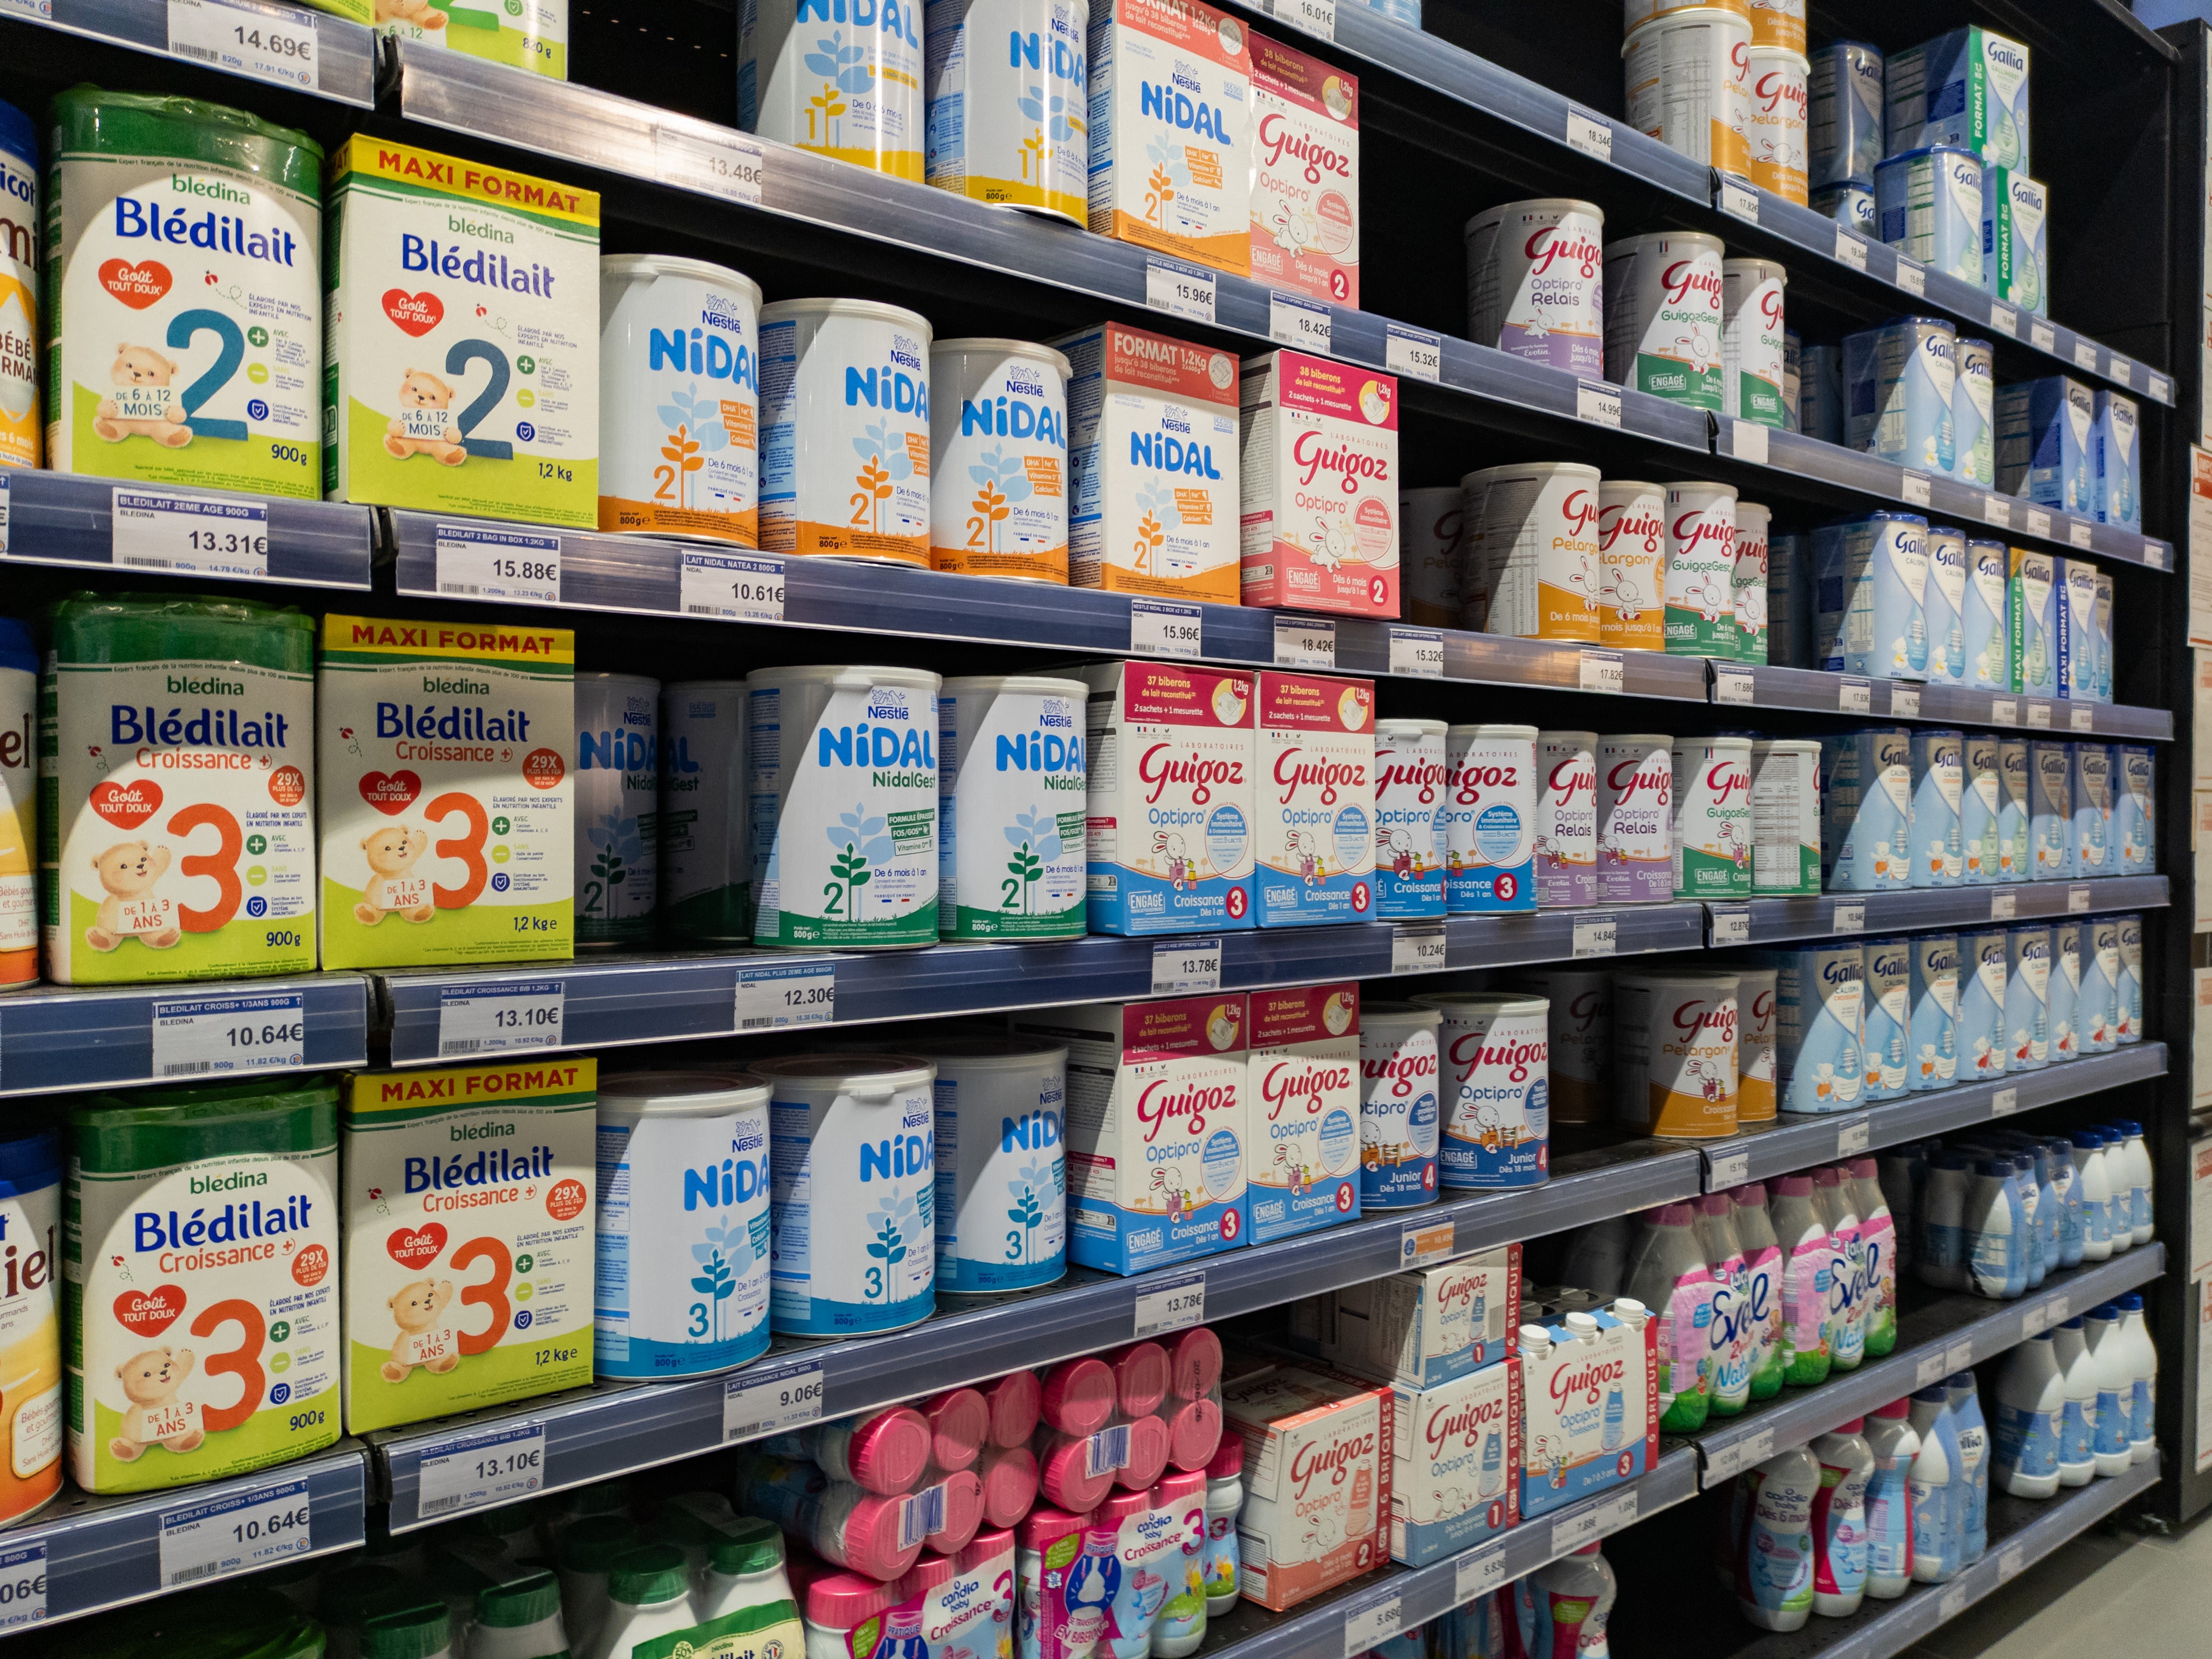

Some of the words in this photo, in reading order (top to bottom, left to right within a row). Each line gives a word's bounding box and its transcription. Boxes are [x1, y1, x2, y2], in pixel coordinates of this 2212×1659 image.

[1301, 1, 1333, 25] 16.01€
[234, 25, 311, 60] 14.69€
[1274, 51, 1304, 73] biberons
[1988, 42, 2023, 72] Gallia
[1294, 120, 1350, 147] LABORATOIRES
[1260, 113, 1349, 184] Guigoz
[379, 150, 454, 184] MAXI
[465, 171, 580, 213] FORMAT
[709, 156, 762, 184] 13.48€
[172, 173, 250, 206] blédina
[2012, 181, 2042, 212] Gallia
[1740, 199, 1758, 215] 17.82€
[116, 196, 297, 267] Blédilait
[449, 215, 514, 244] blédina
[402, 233, 554, 299] Blédilait
[1252, 248, 1282, 271] ENGAGÉ
[118, 267, 153, 284] Goût
[398, 297, 428, 313] Goût
[1176, 284, 1212, 305] 15.96€
[1299, 319, 1331, 337] 18.42€
[1115, 333, 1177, 366] FORMAT
[1410, 351, 1437, 367] 15.32€
[167, 309, 248, 441] 2
[116, 392, 128, 401] DE
[132, 388, 140, 400] 6
[157, 389, 170, 402] 12
[445, 338, 514, 460] 2
[124, 403, 162, 416] MOIS
[1598, 402, 1621, 416] 14.99€
[1331, 432, 1388, 449] LABORATOIRES
[1294, 431, 1387, 494] Guigoz
[653, 465, 676, 499] 2
[120, 496, 172, 510] BLEDILAIT
[174, 501, 201, 512] 2EME
[203, 504, 224, 515] AGE
[226, 506, 249, 517] 900G
[120, 510, 156, 519] BLEDINA
[189, 530, 268, 556] 13.31€
[438, 541, 466, 549] BLEDINA
[439, 529, 475, 540] BLEDILAIT
[482, 533, 498, 542] BAG
[499, 534, 507, 543] IN
[508, 536, 522, 545] BOX
[493, 559, 557, 581] 15.88€
[686, 556, 702, 565] LAIT
[704, 557, 725, 567] NIDAL
[727, 561, 751, 569] NATEA
[758, 564, 775, 572] 800G
[732, 583, 784, 602] 10.61€
[352, 625, 427, 647] MAXI
[439, 631, 554, 655] FORMAT
[1163, 625, 1200, 641] 15.96€
[1302, 638, 1334, 653] 18.42€
[1415, 649, 1443, 662] 15.32€
[167, 675, 244, 696] blédina
[111, 705, 288, 748] Blédilait
[376, 702, 530, 742] Blédilait
[136, 747, 251, 769] Croissance
[396, 741, 494, 762] Croissance
[532, 755, 556, 769] 29X
[277, 772, 300, 786] 29X
[873, 771, 936, 788] NidalGest
[1139, 743, 1243, 805] Guigoz
[1274, 748, 1365, 805] Guigoz
[100, 802, 123, 813] TOUT
[127, 802, 152, 813] DOUX
[368, 792, 388, 801] TOUT
[390, 792, 410, 801] DOUX
[1556, 824, 1591, 837] Relais
[1614, 821, 1657, 835] Relais
[424, 792, 489, 909] 3
[167, 802, 242, 933] 3
[394, 893, 419, 906] ANS
[824, 882, 843, 914] 2
[1394, 882, 1441, 894] Croissance
[1130, 894, 1163, 909] ENGAGÉ
[1174, 895, 1224, 907] Croissance
[1231, 891, 1242, 914] 3
[132, 916, 162, 929] ANS
[742, 971, 754, 979] LAIT
[1182, 959, 1217, 974] 13.78€
[442, 988, 475, 996] BLEDILAIT
[477, 986, 517, 994] CROISSANCE
[784, 987, 834, 1006] 12.30€
[159, 1004, 202, 1014] BLEDILAIT
[204, 1001, 240, 1011] CROISS+
[242, 999, 269, 1008] 1/3ANS
[495, 1007, 558, 1028] 13.10€
[226, 1023, 303, 1047] 10.64€
[382, 1079, 455, 1102] MAXI
[466, 1069, 578, 1096] FORMAT
[1262, 1062, 1349, 1120] Guigoz
[1137, 1080, 1236, 1142] Guigoz
[405, 1146, 554, 1194] Blédilait
[1508, 1153, 1536, 1165] Junior
[423, 1187, 518, 1213] Croissance
[135, 1195, 312, 1253] Blédilait
[1171, 1222, 1218, 1240] Croissance
[159, 1243, 275, 1274] Croissance
[864, 1266, 882, 1299] 3
[1438, 1273, 1488, 1302] Guigoz
[1507, 1251, 1519, 1318] BRIQUES
[450, 1237, 512, 1355] 3
[1167, 1292, 1202, 1309] 13.78€
[688, 1303, 709, 1337] 3
[190, 1299, 266, 1431] 3
[742, 1373, 779, 1388] CROISSANCE
[780, 1368, 796, 1377] NIDAL
[780, 1382, 822, 1407] 9.06€
[1509, 1370, 1518, 1448] BRIQUES
[1427, 1397, 1503, 1459] Guigoz
[1382, 1402, 1391, 1485] BRIQUES
[476, 1450, 540, 1479] 13.10€
[1291, 1432, 1373, 1500] Guigoz
[233, 1507, 309, 1542] 10.64€
[1138, 1513, 1172, 1534] candia
[1144, 1529, 1161, 1540] baby
[1086, 1543, 1114, 1554] PRATIQUE
[1125, 1532, 1180, 1562] Croissance
[942, 1580, 979, 1608] candia
[931, 1599, 992, 1642] Croissance
